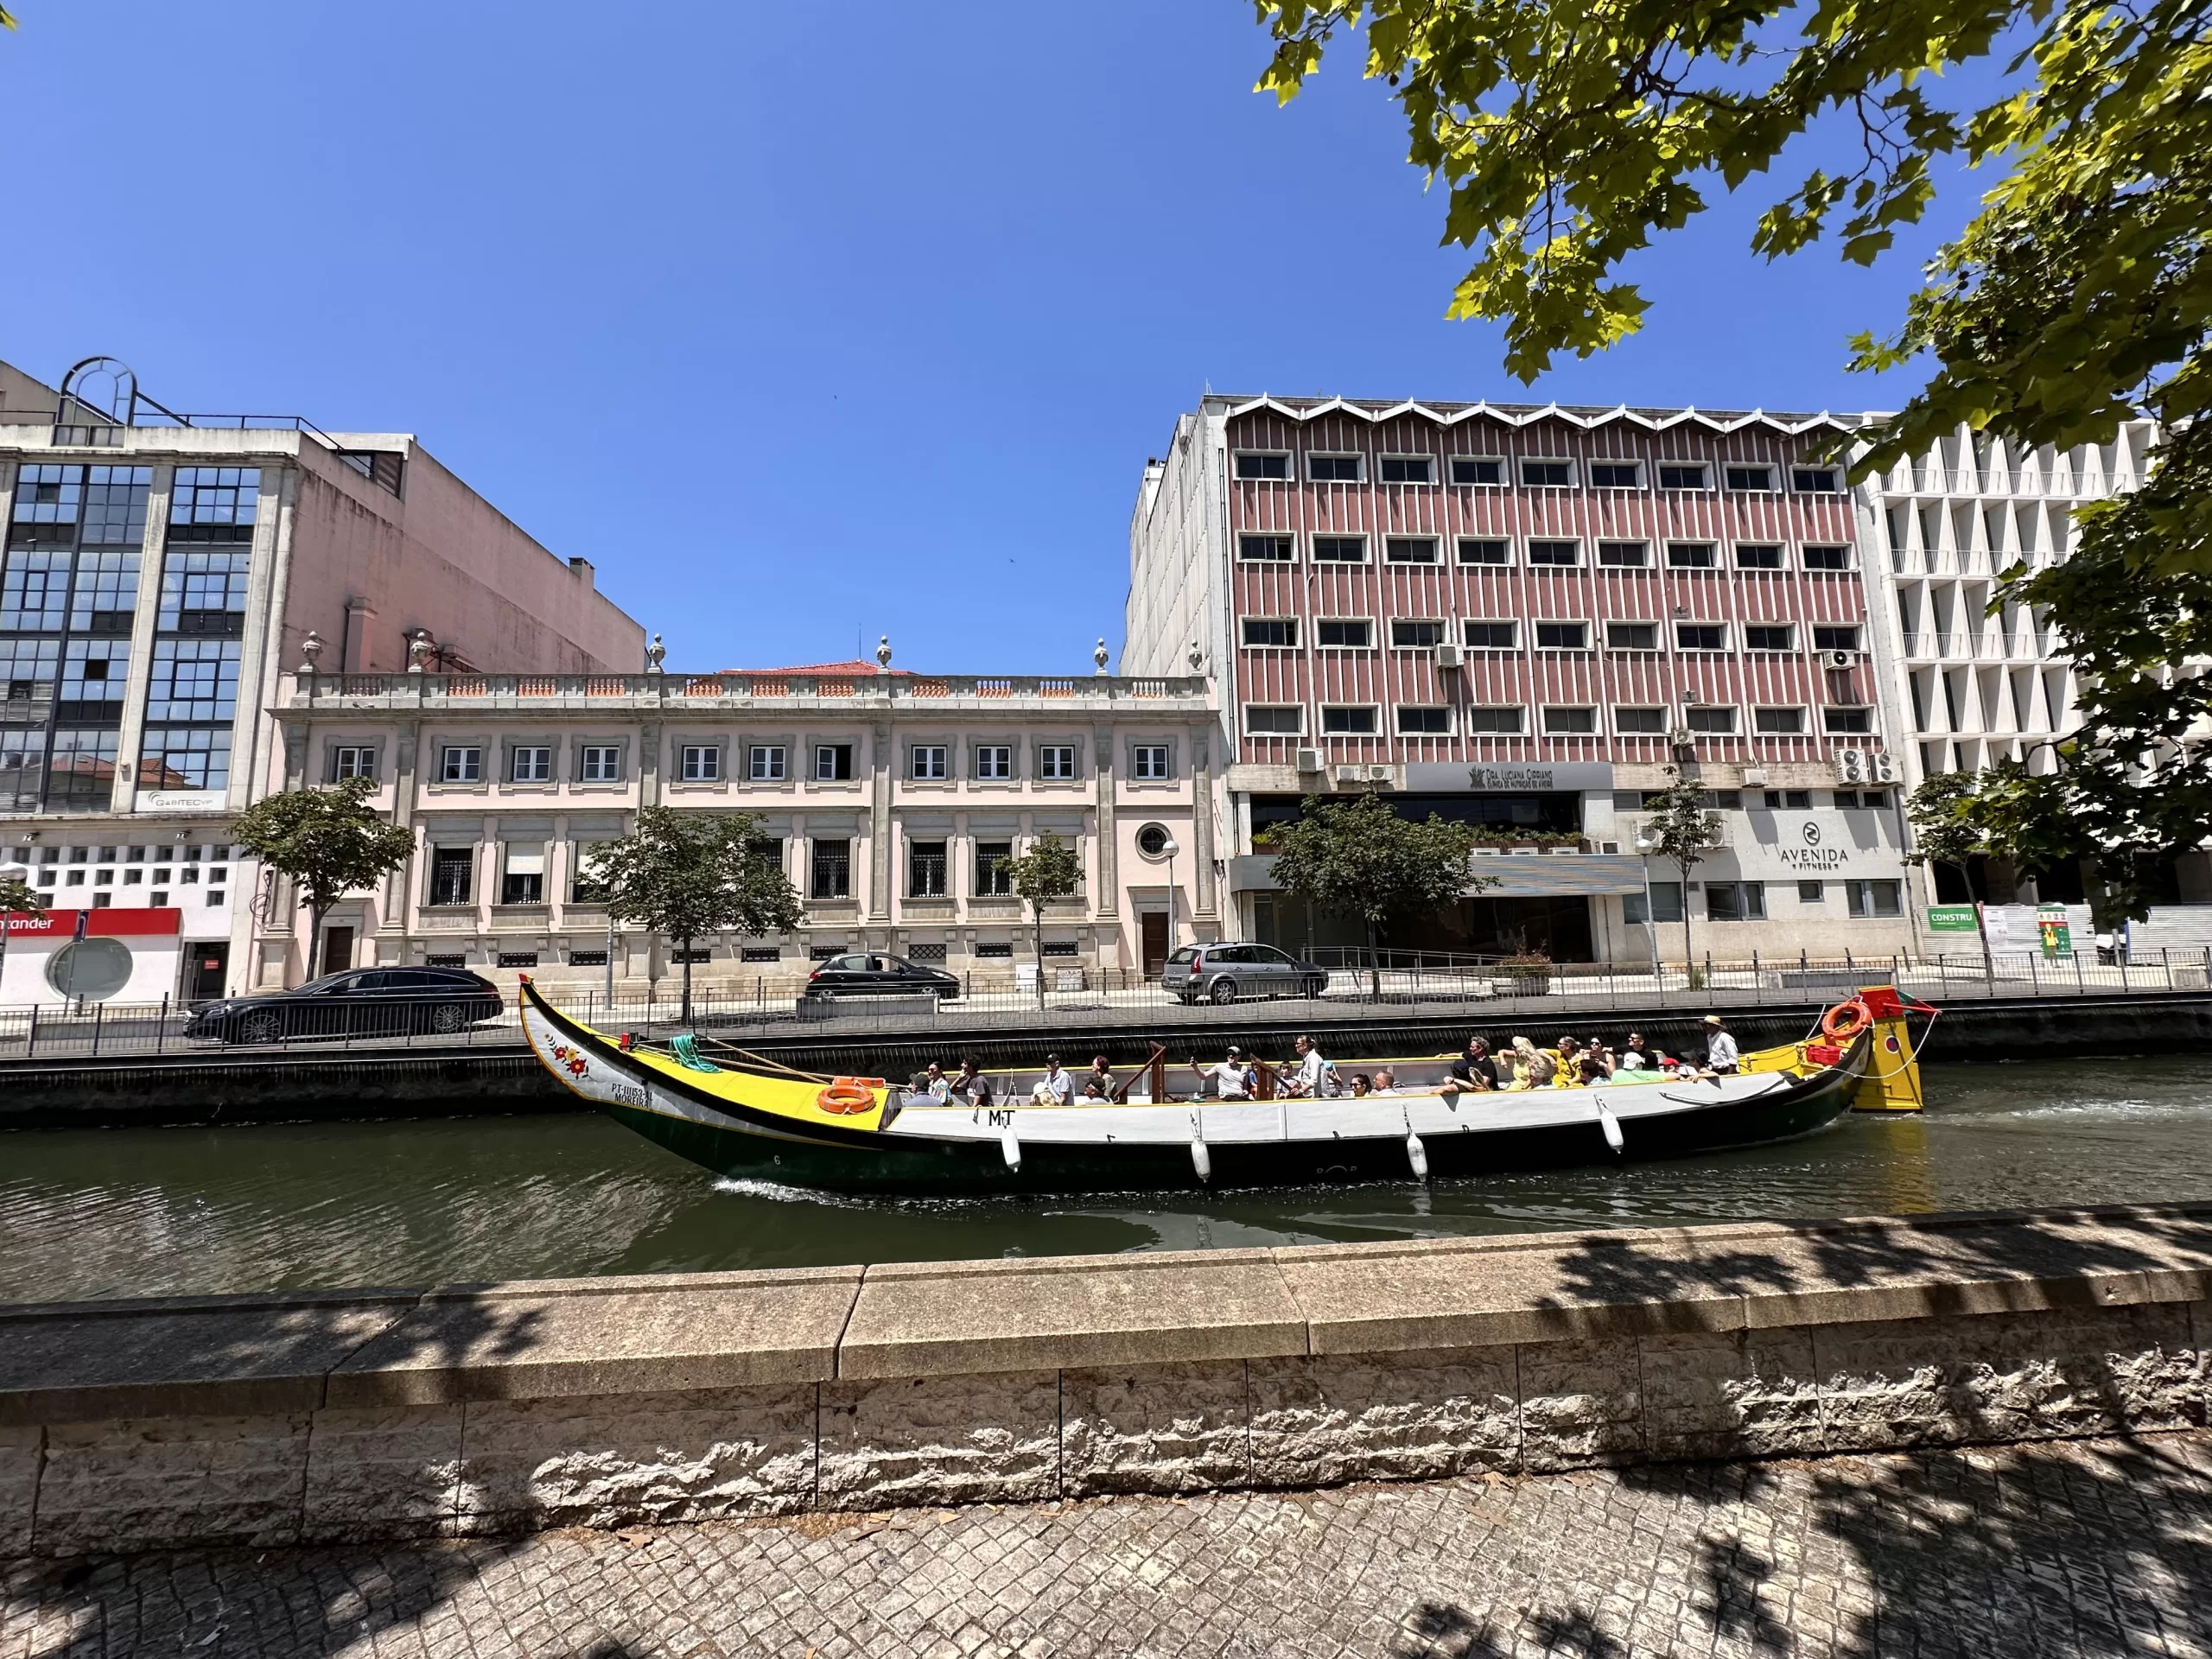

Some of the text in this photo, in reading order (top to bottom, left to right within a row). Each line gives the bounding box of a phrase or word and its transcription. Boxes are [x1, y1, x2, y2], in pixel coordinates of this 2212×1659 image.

[1781, 849, 1849, 862] AVENIDA
[1799, 862, 1833, 871] FITNESS
[1931, 913, 1973, 922] CONSTRU
[614, 1092, 649, 1109] MOREIRA
